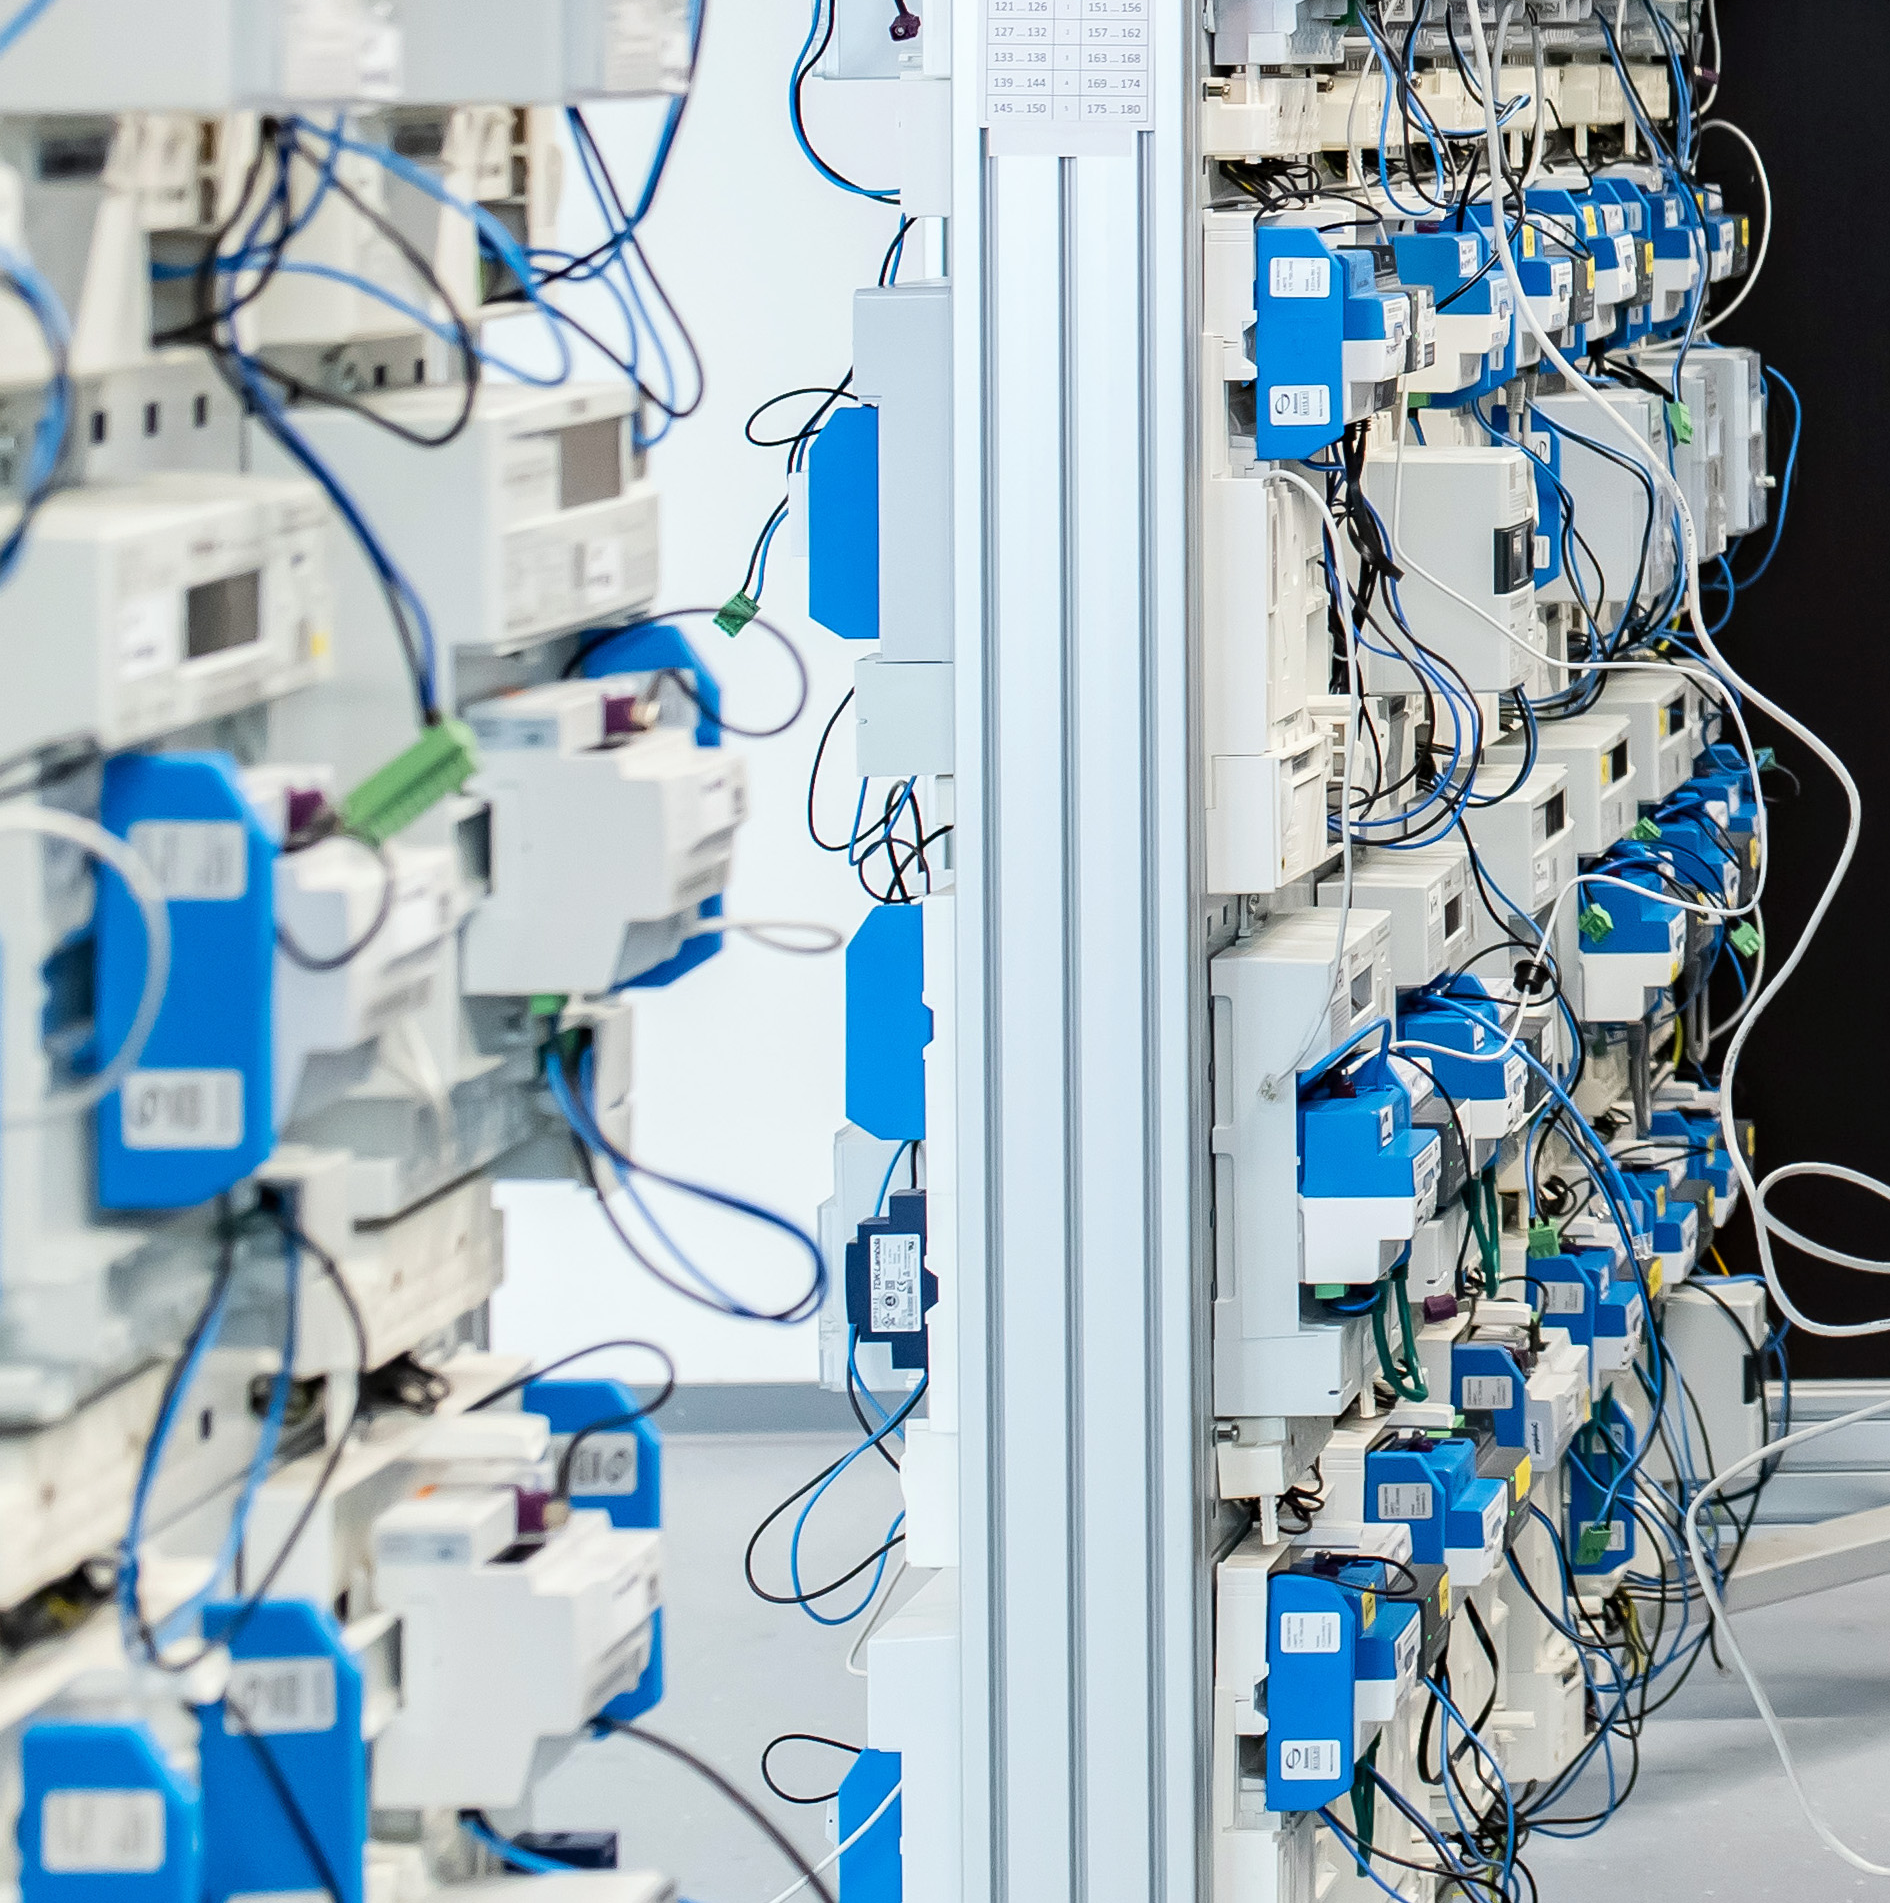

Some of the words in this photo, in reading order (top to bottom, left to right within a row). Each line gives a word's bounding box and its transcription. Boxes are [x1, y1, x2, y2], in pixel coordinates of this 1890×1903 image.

[996, 2, 1013, 11] 121
[1029, 2, 1047, 11] 126
[1089, 3, 1107, 12] 151
[1122, 3, 1141, 12] 156
[995, 27, 1014, 36] 127
[1029, 27, 1046, 37] 132
[1089, 28, 1107, 37] 157
[1122, 28, 1140, 38] 162
[994, 53, 1013, 62] 133
[1028, 53, 1046, 62] 138
[1088, 54, 1107, 62] 163
[1121, 54, 1141, 63] 168
[994, 78, 1013, 87] 139
[1027, 78, 1045, 87] 144
[1088, 79, 1107, 88] 169
[1121, 79, 1140, 88] 174
[994, 104, 1012, 113] 145
[1027, 104, 1046, 113] 150
[1088, 104, 1107, 113] 175
[1121, 105, 1140, 114] 180
